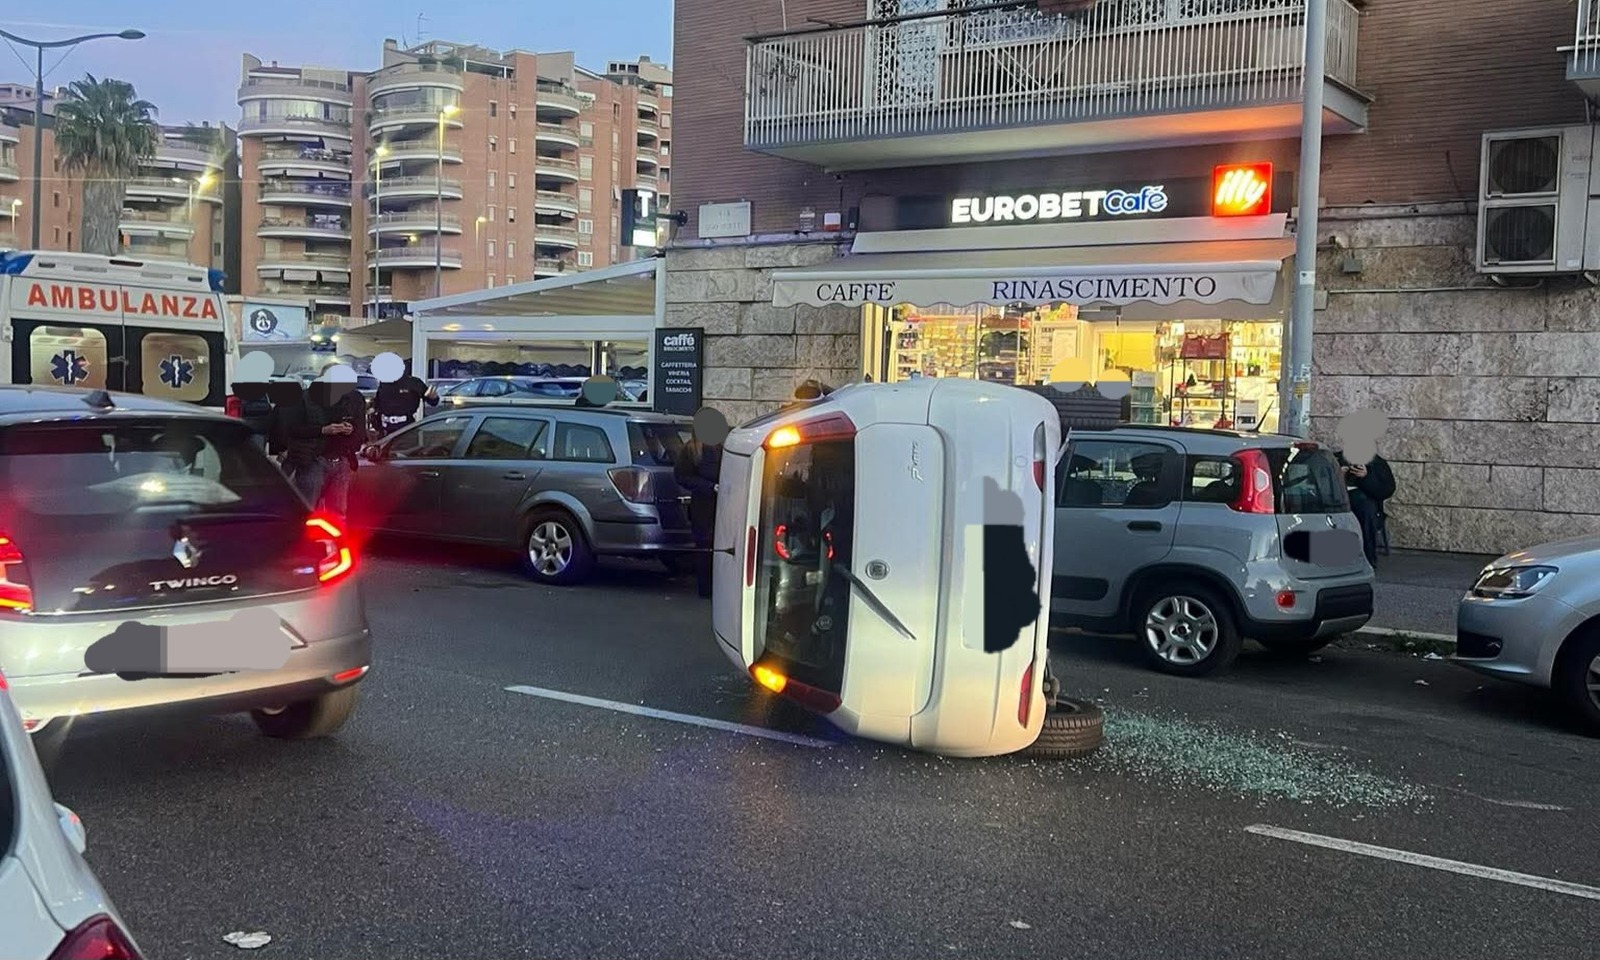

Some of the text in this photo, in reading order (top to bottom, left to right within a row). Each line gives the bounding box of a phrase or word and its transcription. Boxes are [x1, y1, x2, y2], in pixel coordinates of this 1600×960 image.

[637, 190, 653, 217] T
[1216, 169, 1267, 211] illy
[951, 185, 1168, 223] EUROBET Café
[27, 283, 218, 319] AMBULANZA
[992, 276, 1217, 299] RINASCIMENTO
[663, 333, 695, 346] caffé
[150, 574, 237, 590] TWINGO
